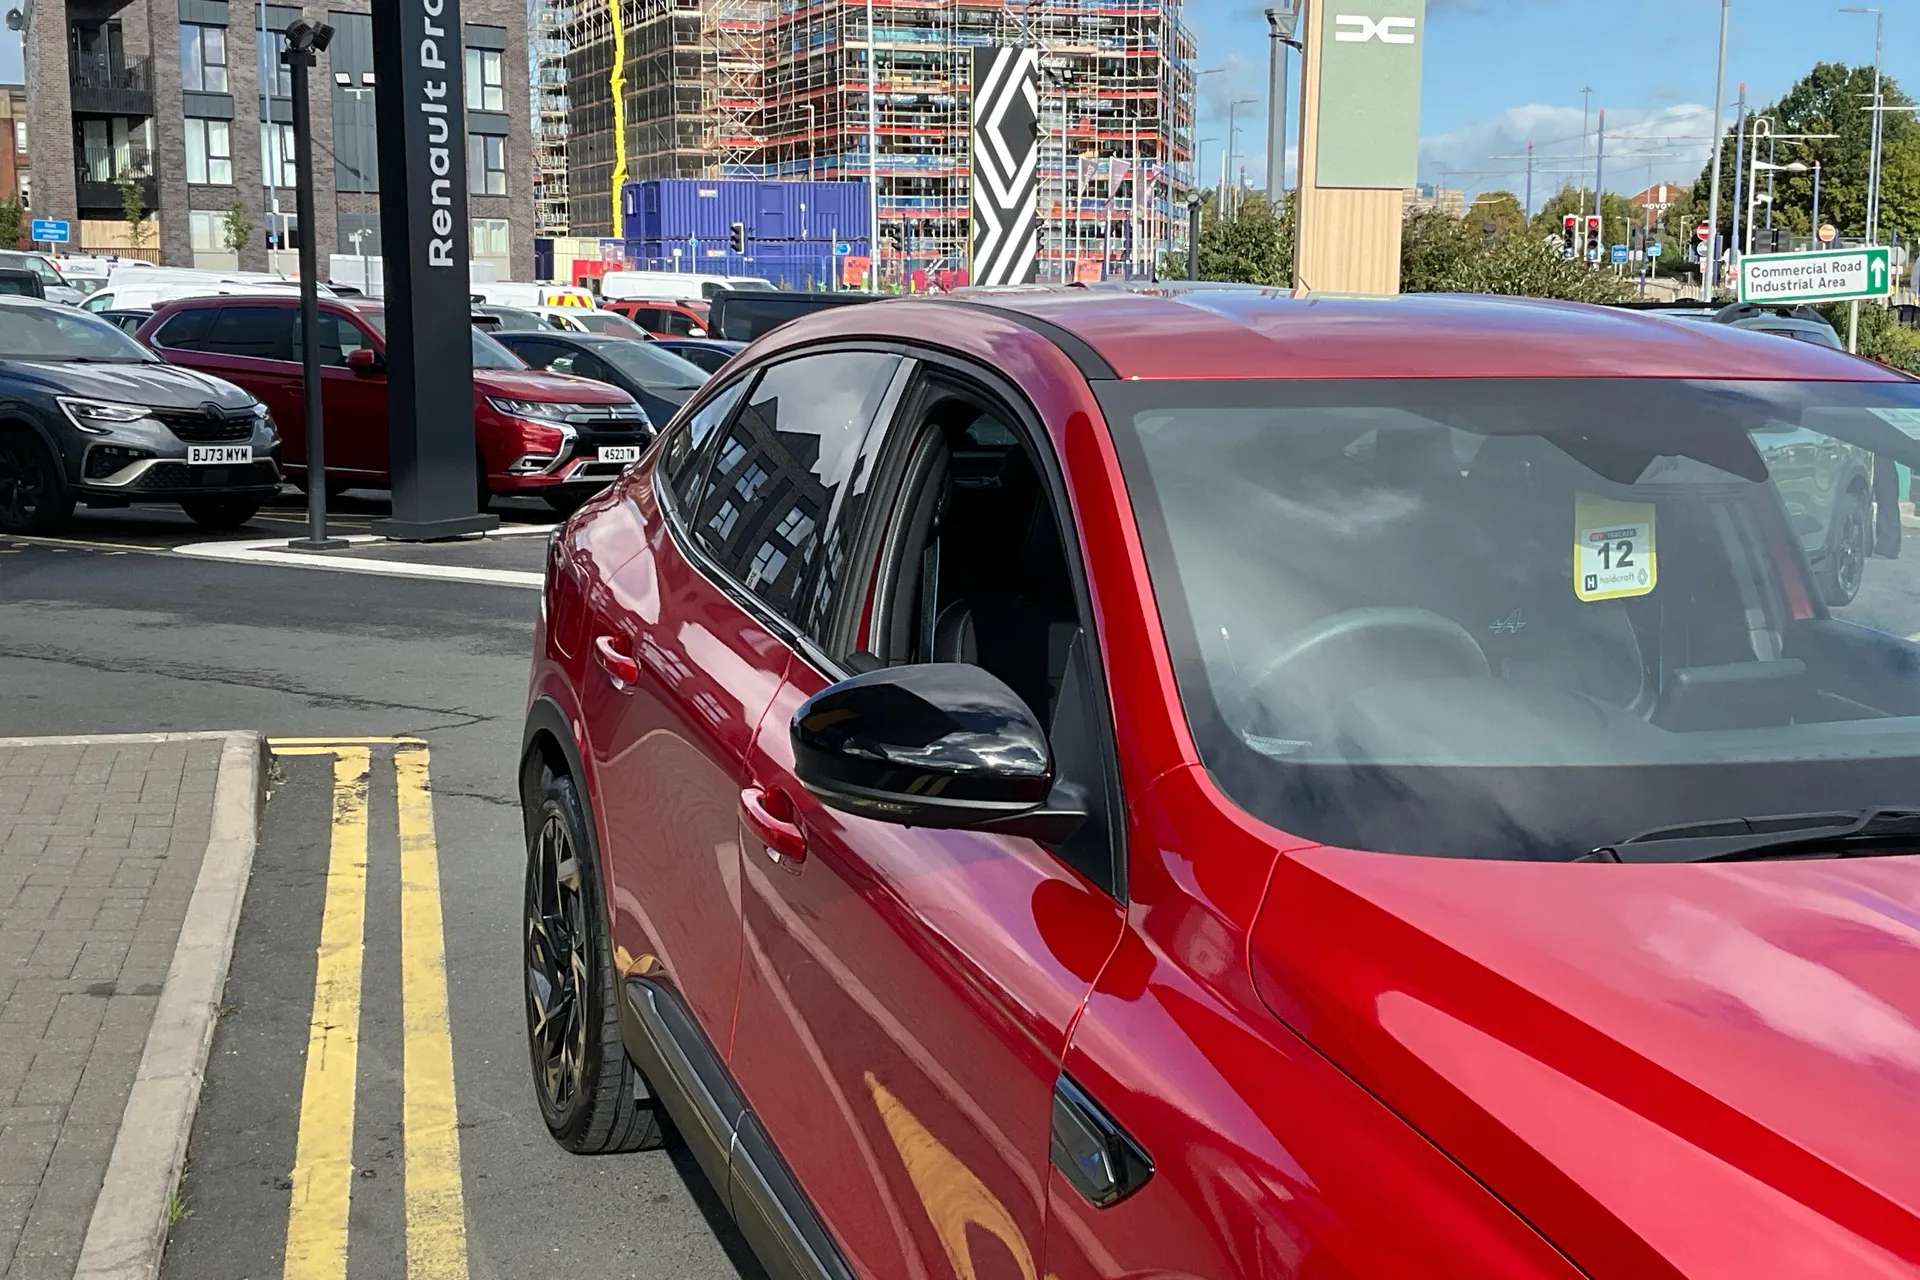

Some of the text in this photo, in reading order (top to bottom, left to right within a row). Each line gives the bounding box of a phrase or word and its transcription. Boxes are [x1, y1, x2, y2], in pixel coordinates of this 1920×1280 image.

[420, 0, 454, 267] Renault Pro
[1751, 260, 1862, 278] Commercial Road
[1751, 277, 1846, 293] Industrial Area
[193, 448, 247, 461] BJ73 MYM
[605, 449, 625, 460] 4523
[1598, 540, 1634, 570] 12
